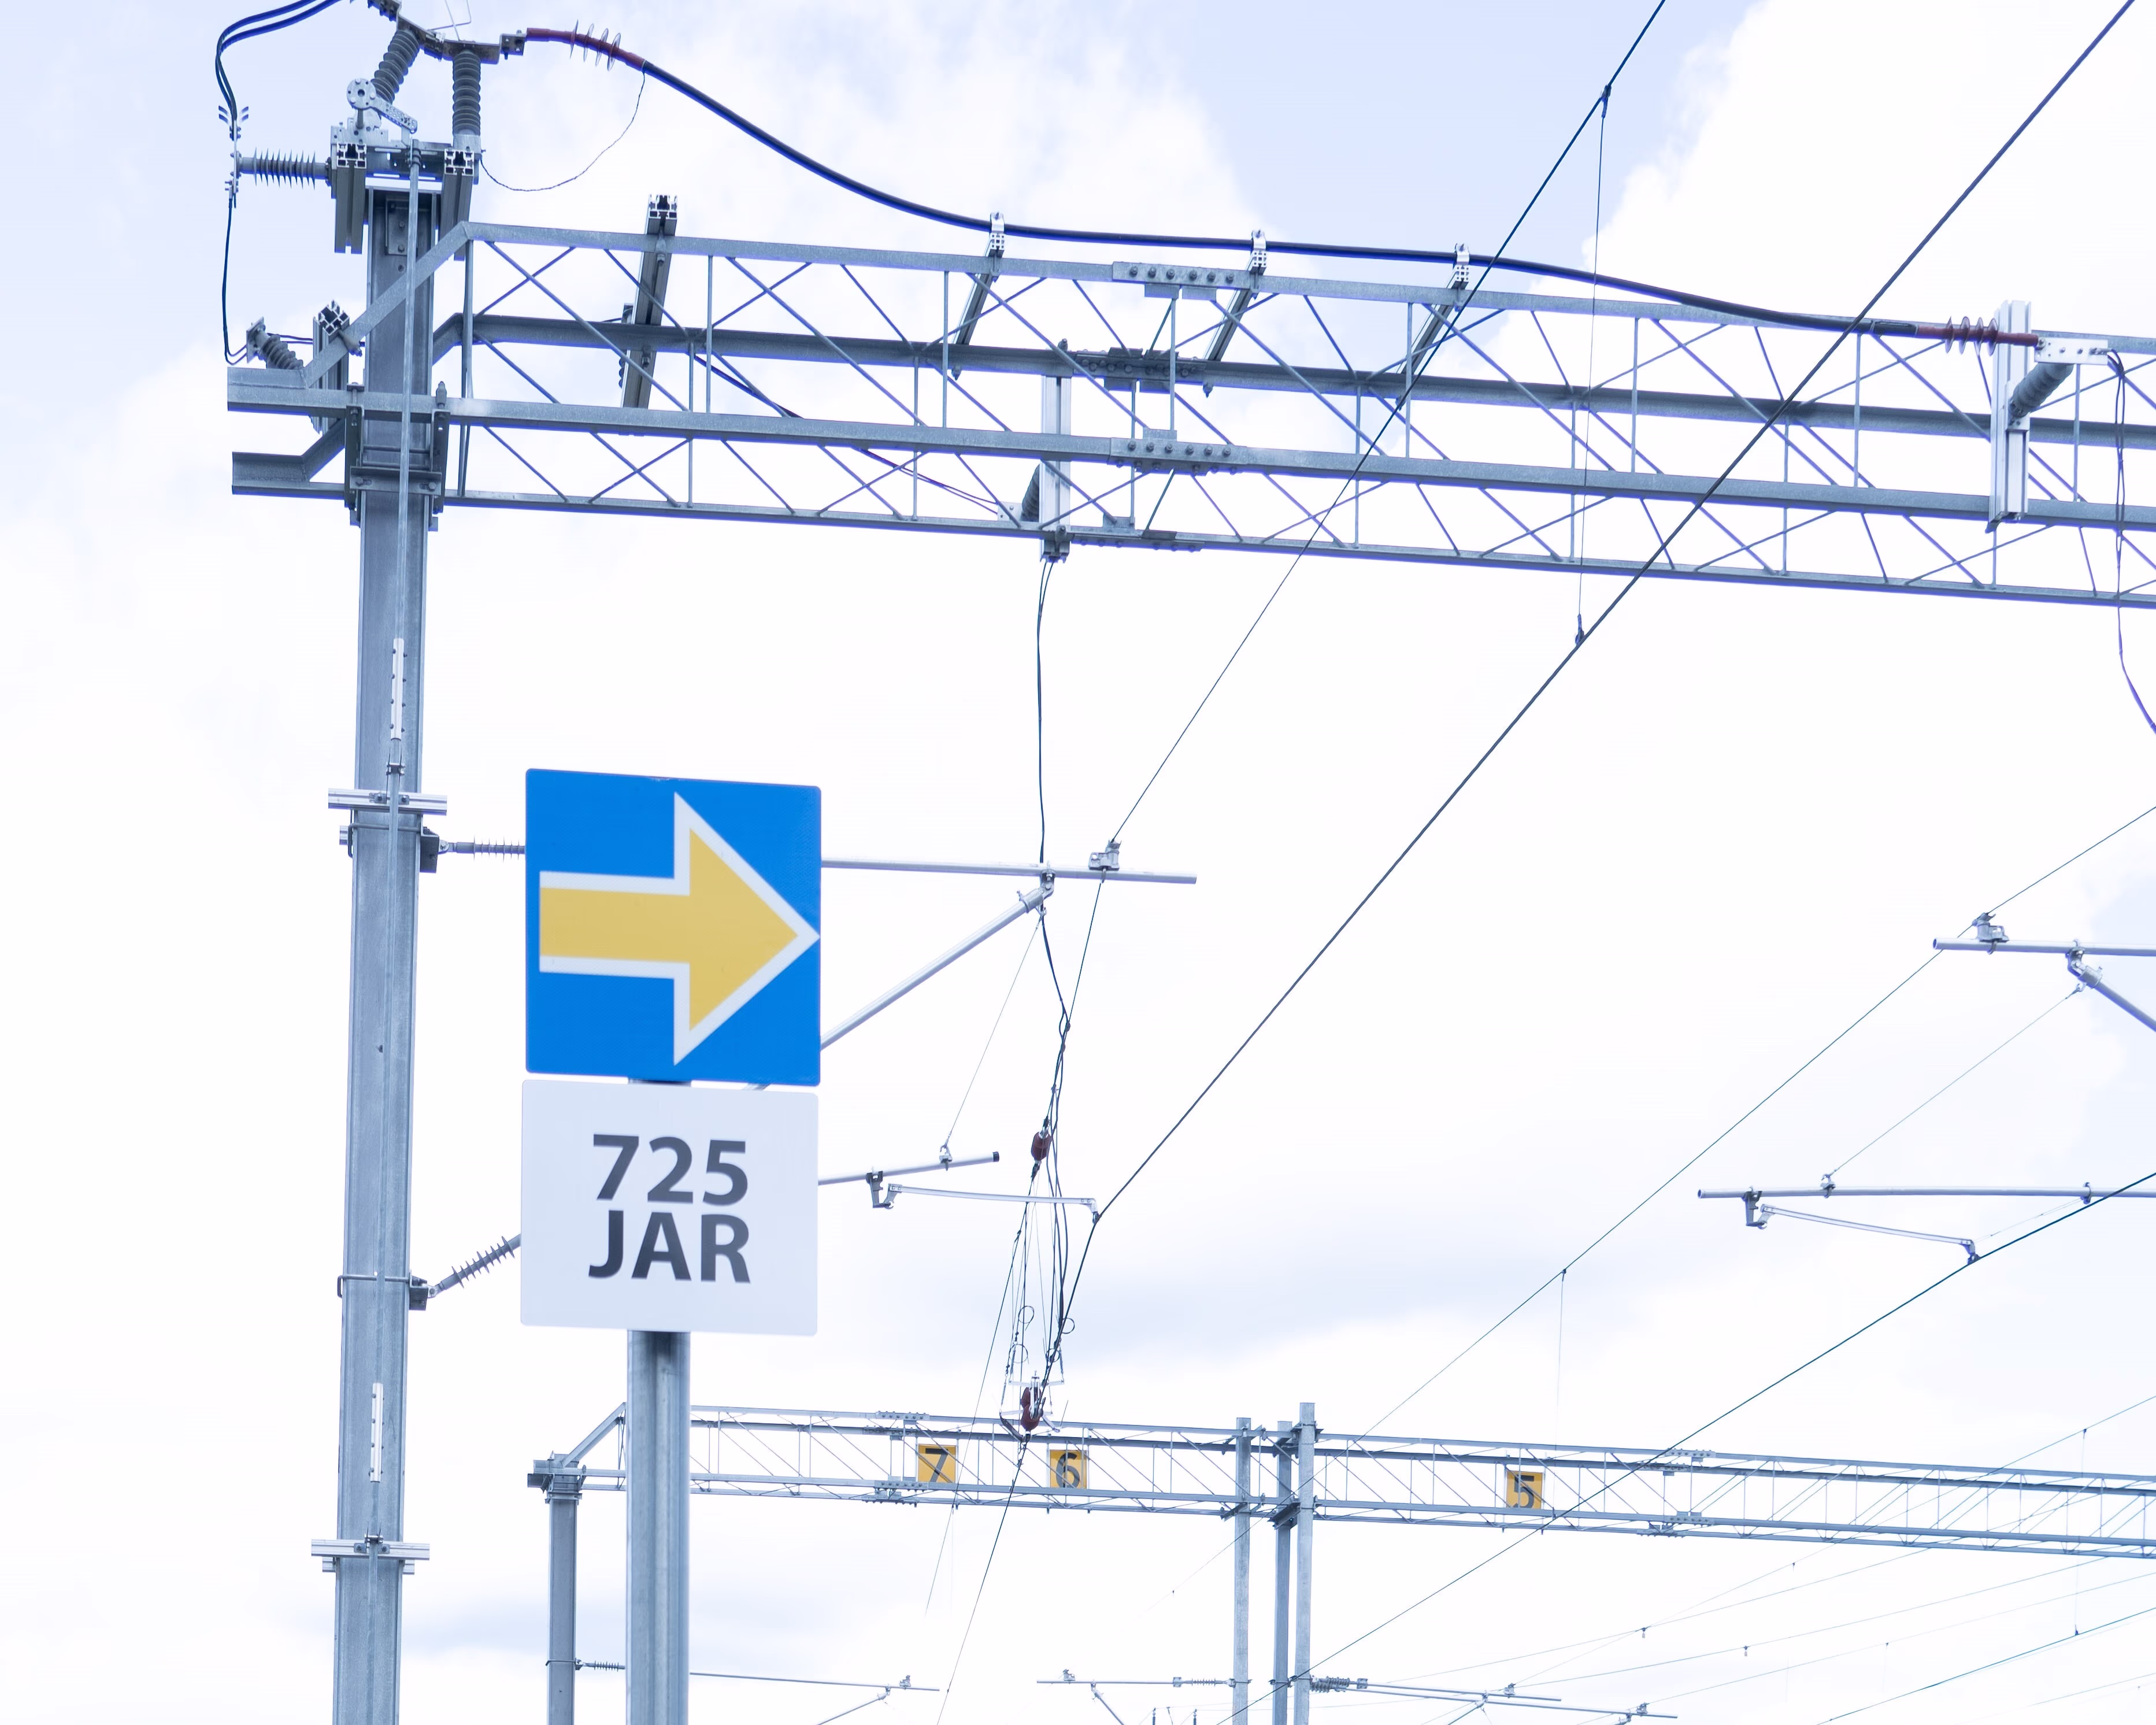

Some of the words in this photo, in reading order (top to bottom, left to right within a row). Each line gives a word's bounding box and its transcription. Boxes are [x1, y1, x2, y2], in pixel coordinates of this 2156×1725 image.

[593, 1134, 748, 1206] 725
[588, 1209, 751, 1283] JAR
[925, 1448, 949, 1482] 7
[1055, 1453, 1080, 1488] 6
[1513, 1474, 1534, 1508] 5
